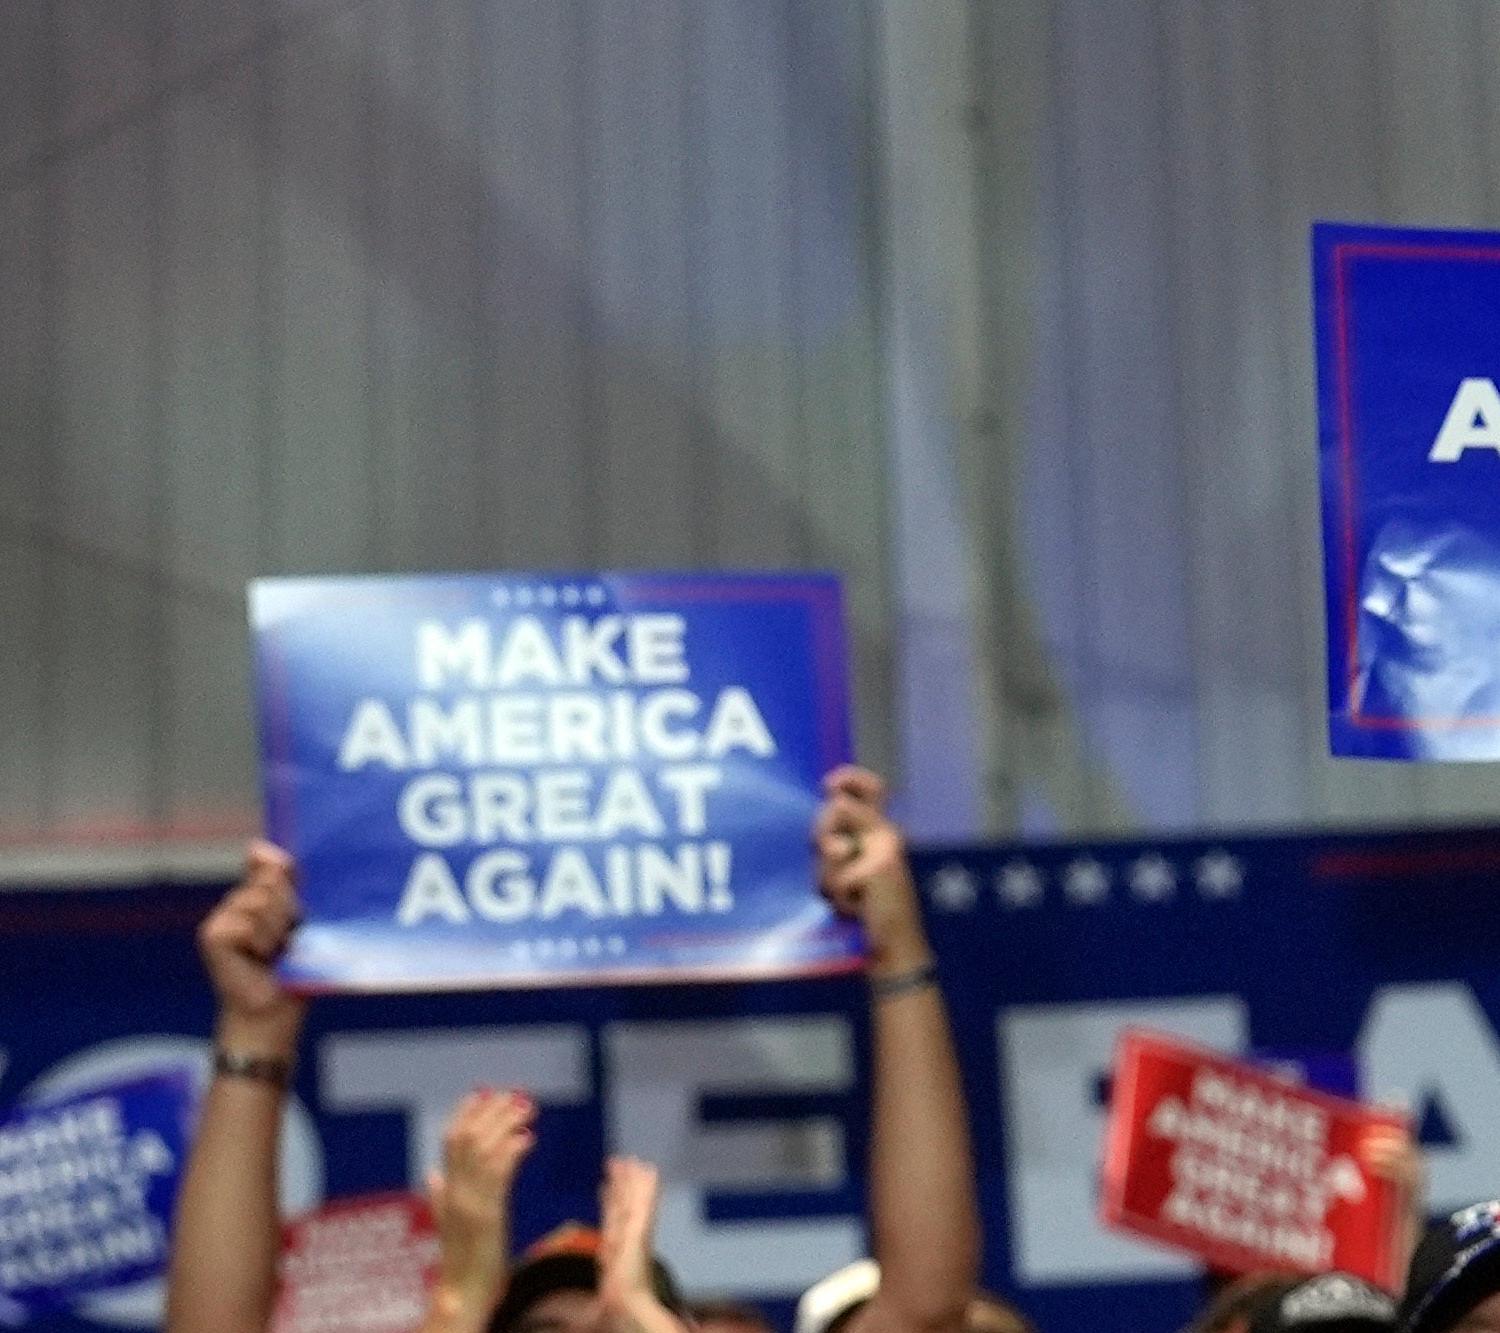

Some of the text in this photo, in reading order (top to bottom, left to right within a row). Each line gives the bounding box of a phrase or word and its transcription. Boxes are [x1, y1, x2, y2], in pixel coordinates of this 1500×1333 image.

[416, 613, 688, 688] MAKE
[337, 687, 776, 773] AMERICA
[398, 767, 721, 848] GREAT
[397, 844, 731, 926] AGAIN!
